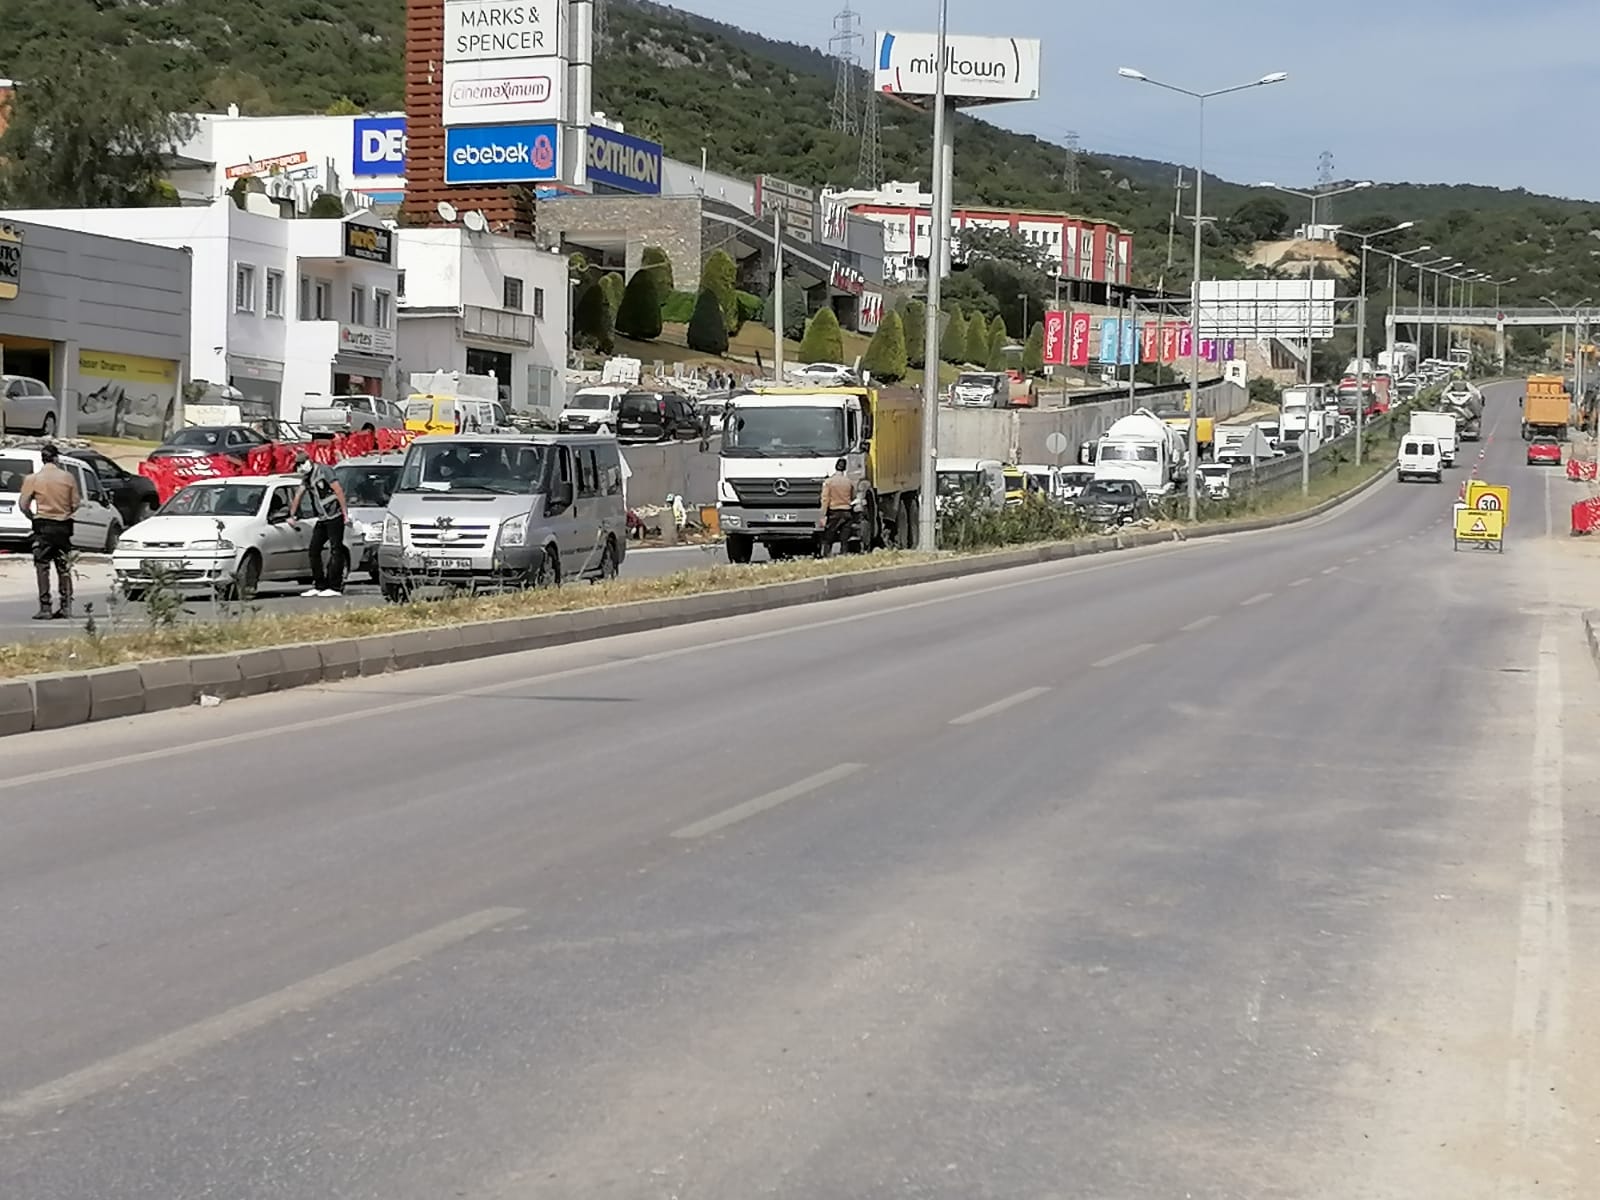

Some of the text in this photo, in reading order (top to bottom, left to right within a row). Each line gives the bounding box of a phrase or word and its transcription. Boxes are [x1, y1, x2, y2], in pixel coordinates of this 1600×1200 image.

[460, 6, 540, 28] MARKS &
[456, 31, 544, 53] SPENCER
[453, 142, 529, 165] ebebek
[1481, 499, 1497, 511] 30
